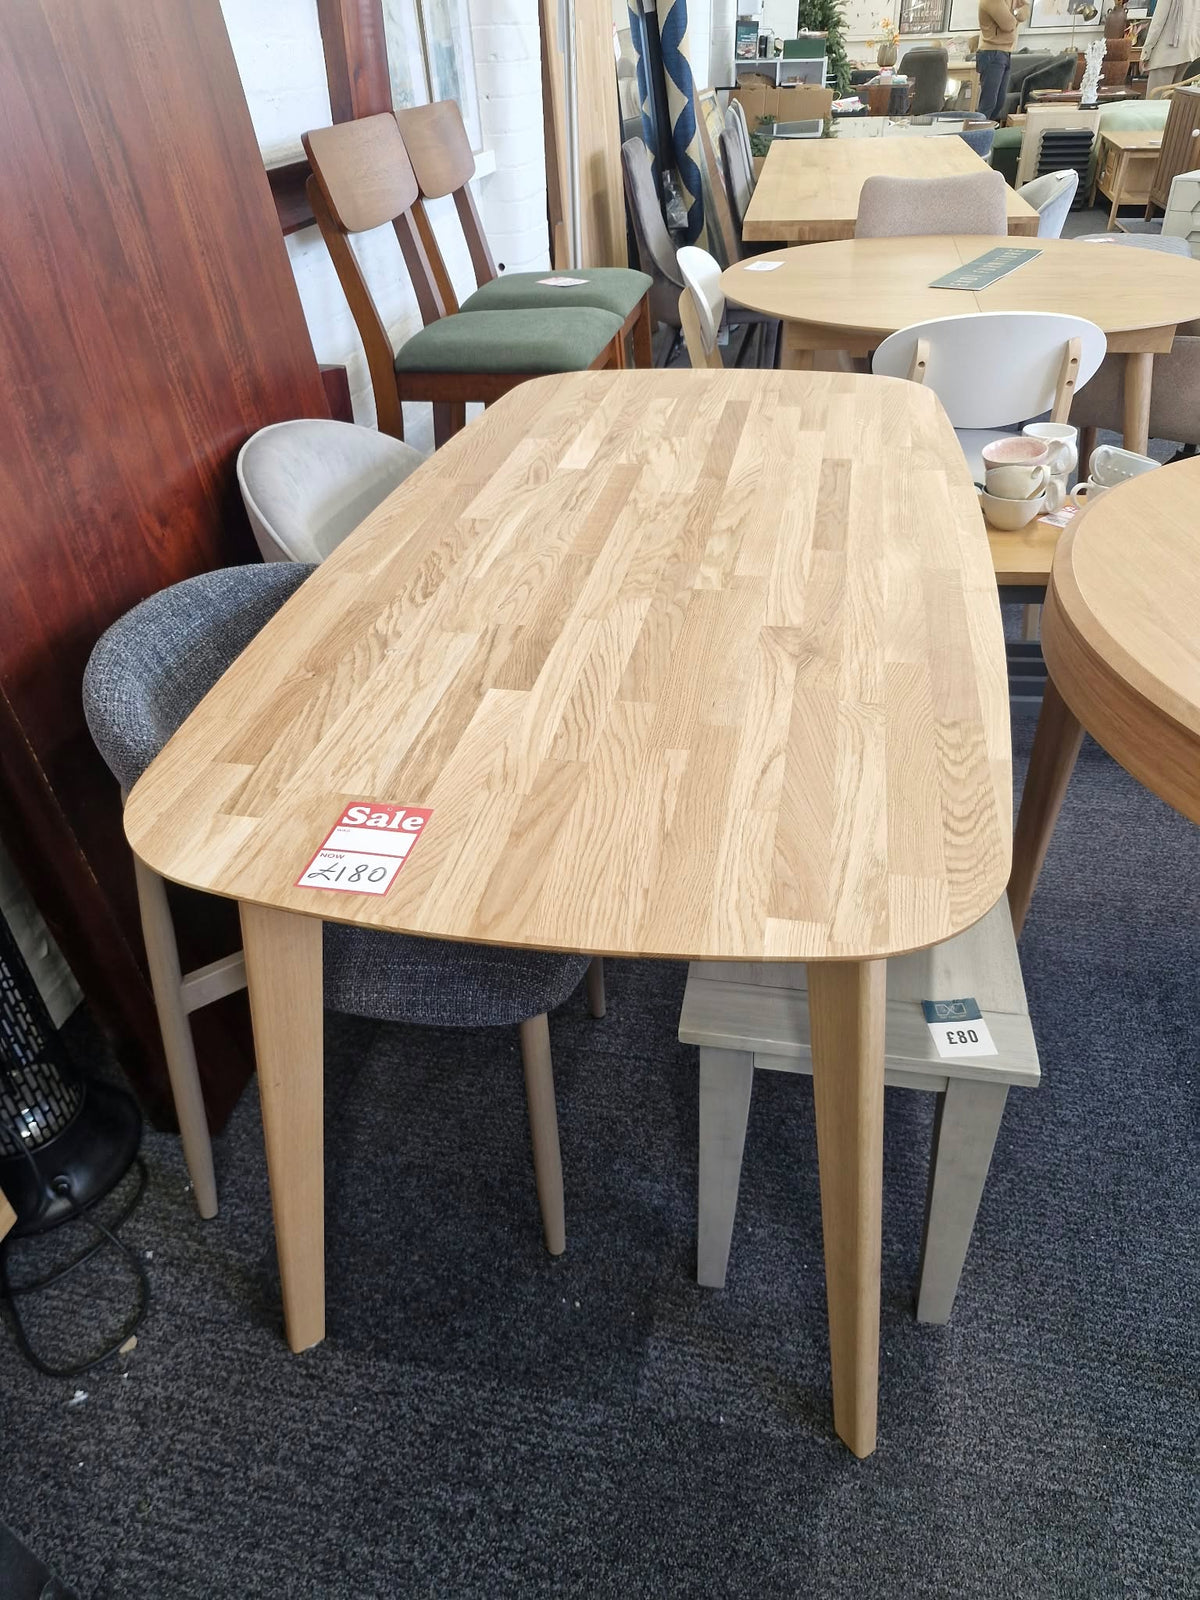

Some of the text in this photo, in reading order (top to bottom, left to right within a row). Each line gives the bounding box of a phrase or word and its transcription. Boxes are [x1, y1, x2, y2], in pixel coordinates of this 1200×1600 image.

[341, 806, 424, 831] Sale
[319, 852, 345, 860] NOW
[307, 862, 387, 883] £180
[946, 1029, 979, 1045] £80
